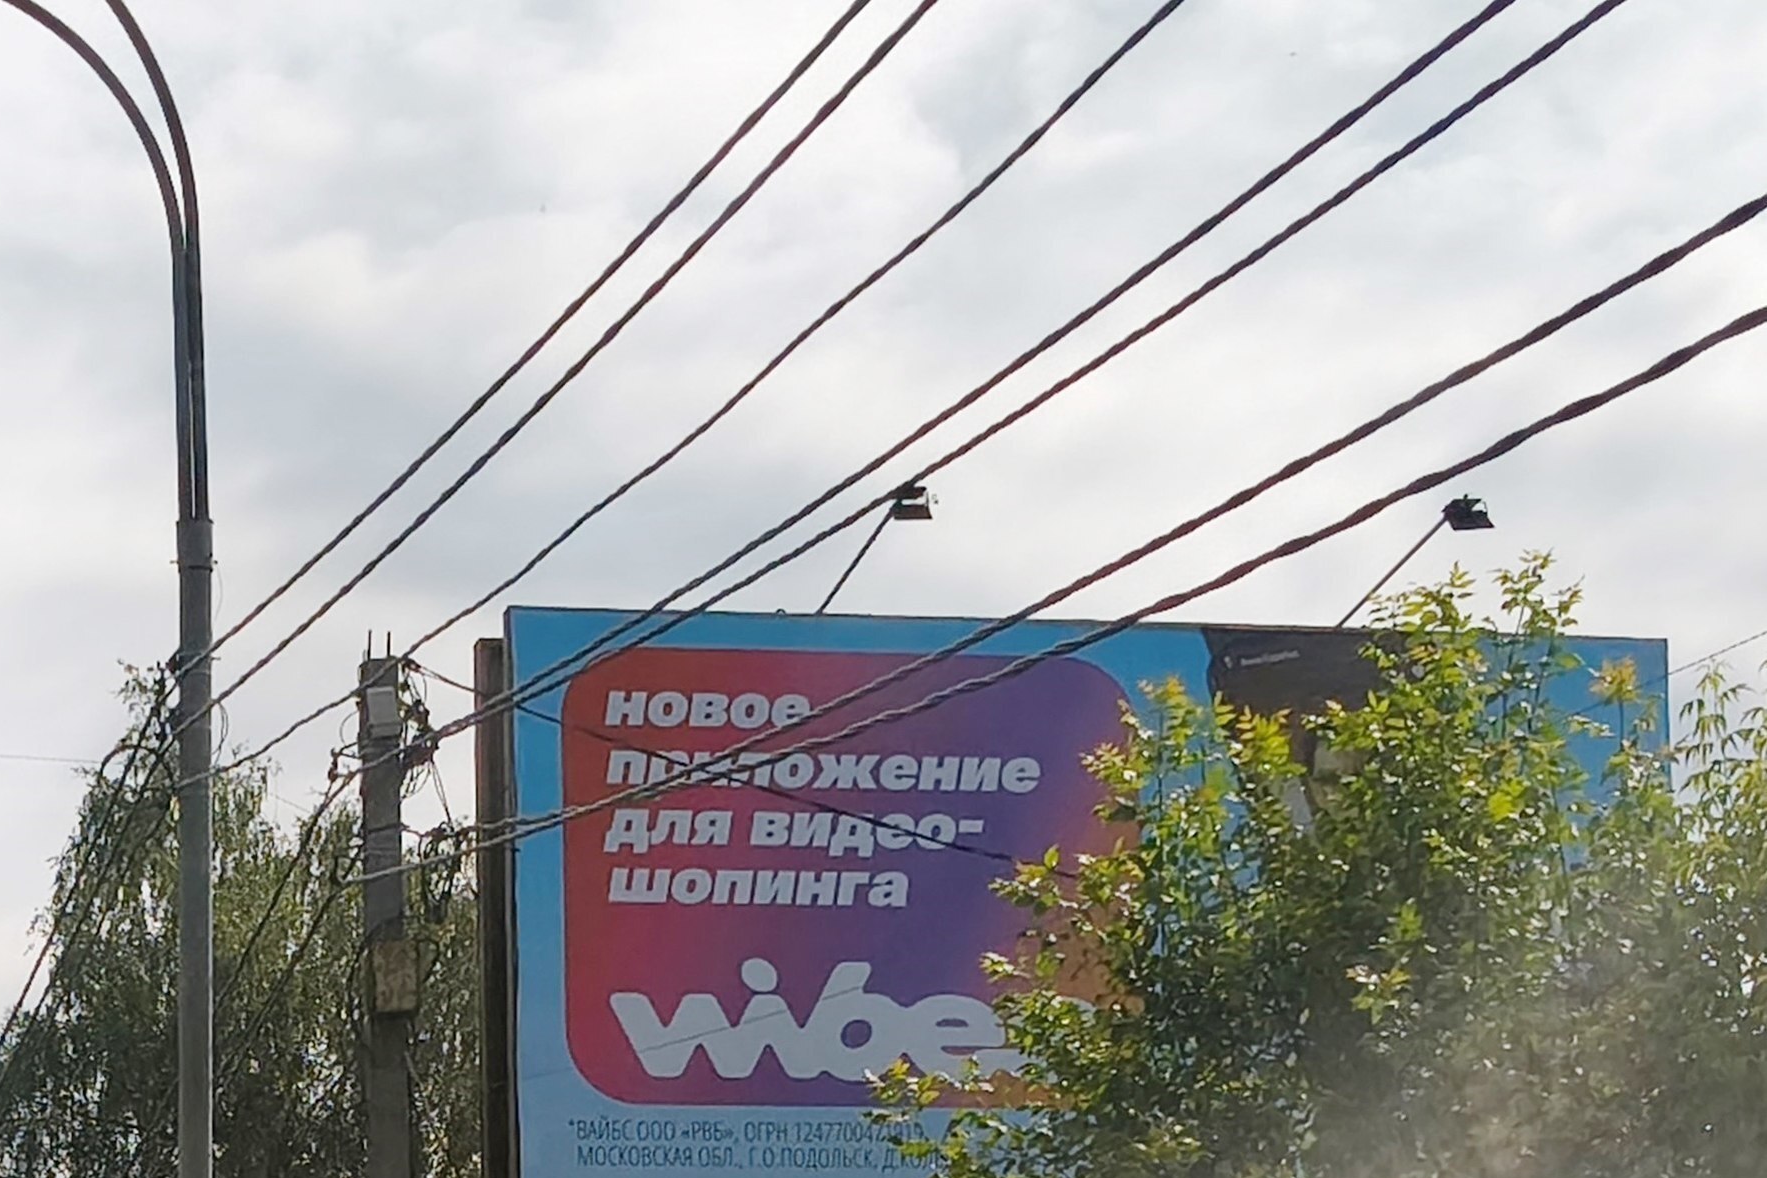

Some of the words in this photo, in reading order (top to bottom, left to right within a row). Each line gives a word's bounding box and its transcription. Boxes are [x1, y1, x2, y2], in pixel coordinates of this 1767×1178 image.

[604, 689, 810, 729] новое
[603, 808, 733, 854] для
[749, 810, 985, 858] видео-
[607, 866, 910, 909] шопинга
[608, 957, 1095, 1084] wibe
[636, 1119, 676, 1142] ООО
[744, 1120, 789, 1143] ОГРН
[577, 1145, 693, 1167] МОСКОВСКАЯ
